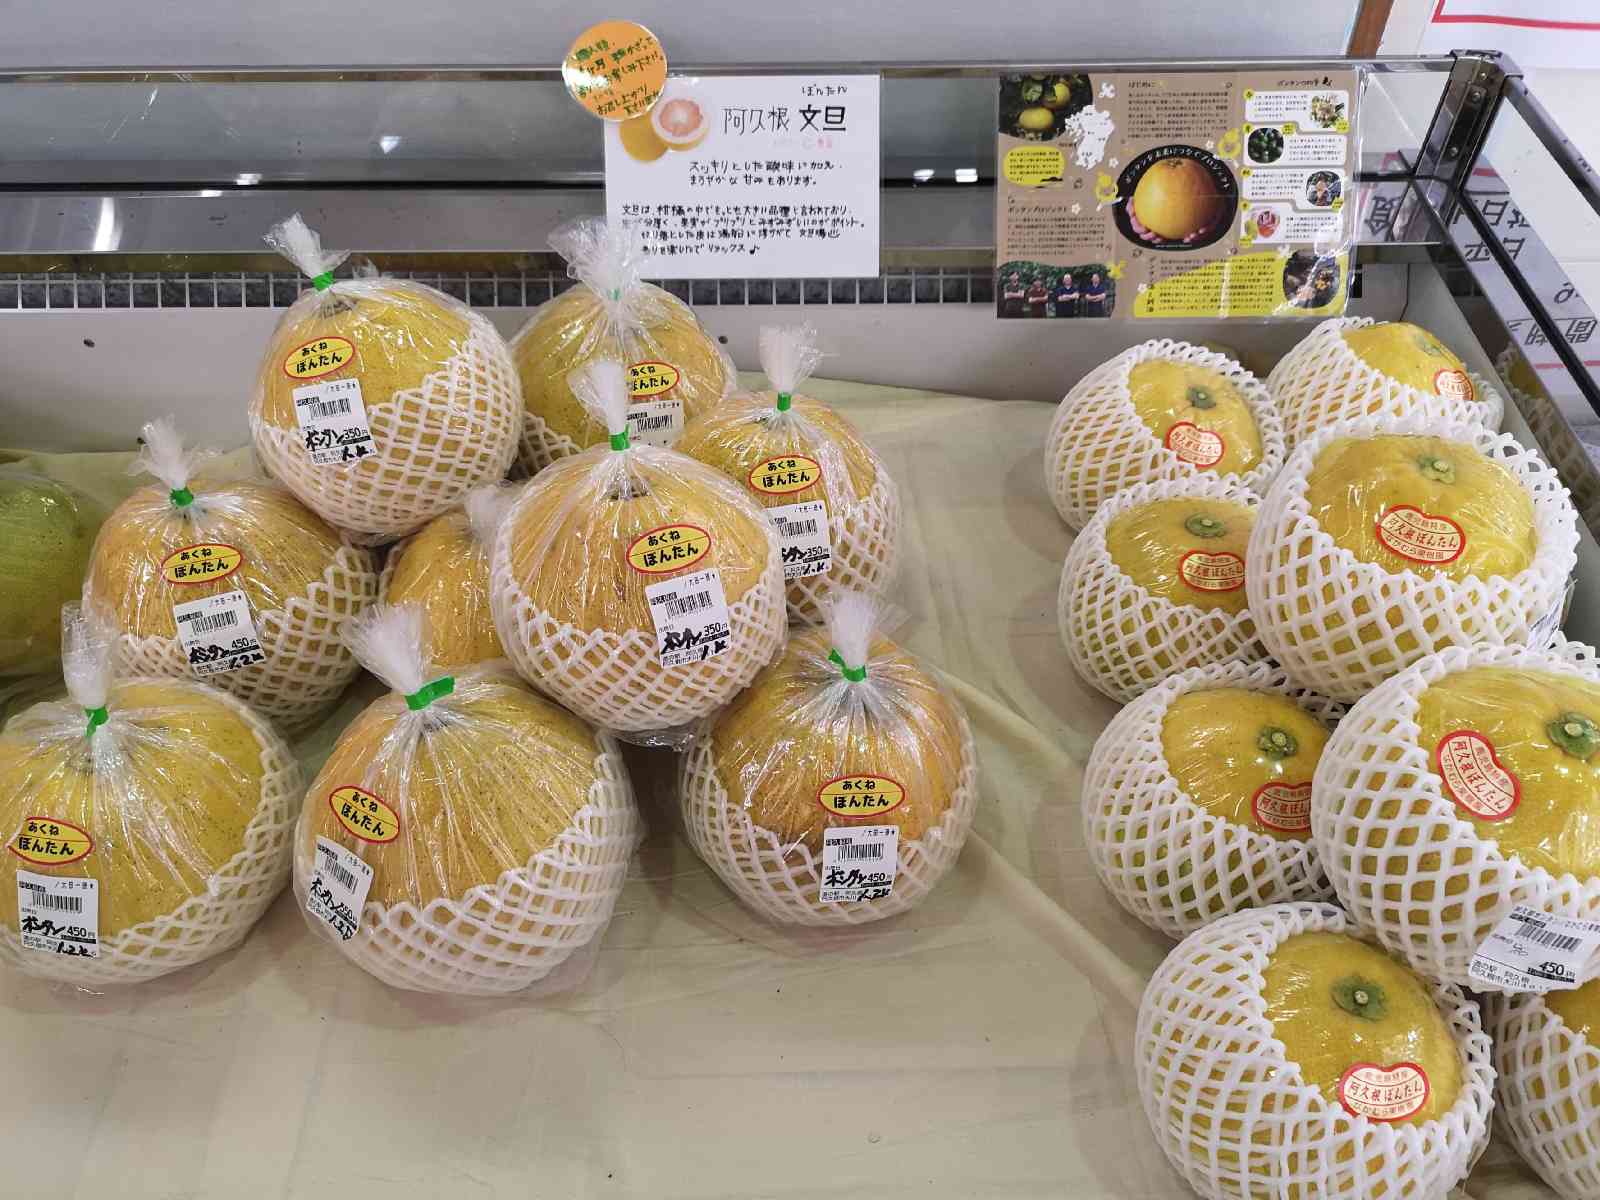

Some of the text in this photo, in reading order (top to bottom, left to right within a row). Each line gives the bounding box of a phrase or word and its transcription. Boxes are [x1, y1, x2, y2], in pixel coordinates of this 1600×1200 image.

[723, 104, 846, 136] 阿久根 文旦
[302, 342, 328, 356] あくね
[296, 352, 342, 374] ぼんたん
[631, 366, 655, 376] あくね
[768, 460, 796, 471] あくね
[762, 471, 811, 488] ぼんたん
[648, 530, 681, 546] あくね
[180, 548, 212, 561] あくね
[643, 543, 699, 567] ぼんたん
[174, 559, 229, 578] ぼんたん
[842, 780, 876, 791] あくね
[352, 791, 378, 813] あくね
[833, 794, 889, 809] ぼんたん
[341, 802, 385, 837] ぼんたん
[28, 821, 60, 836] あくね
[18, 837, 74, 856] ぼんたん
